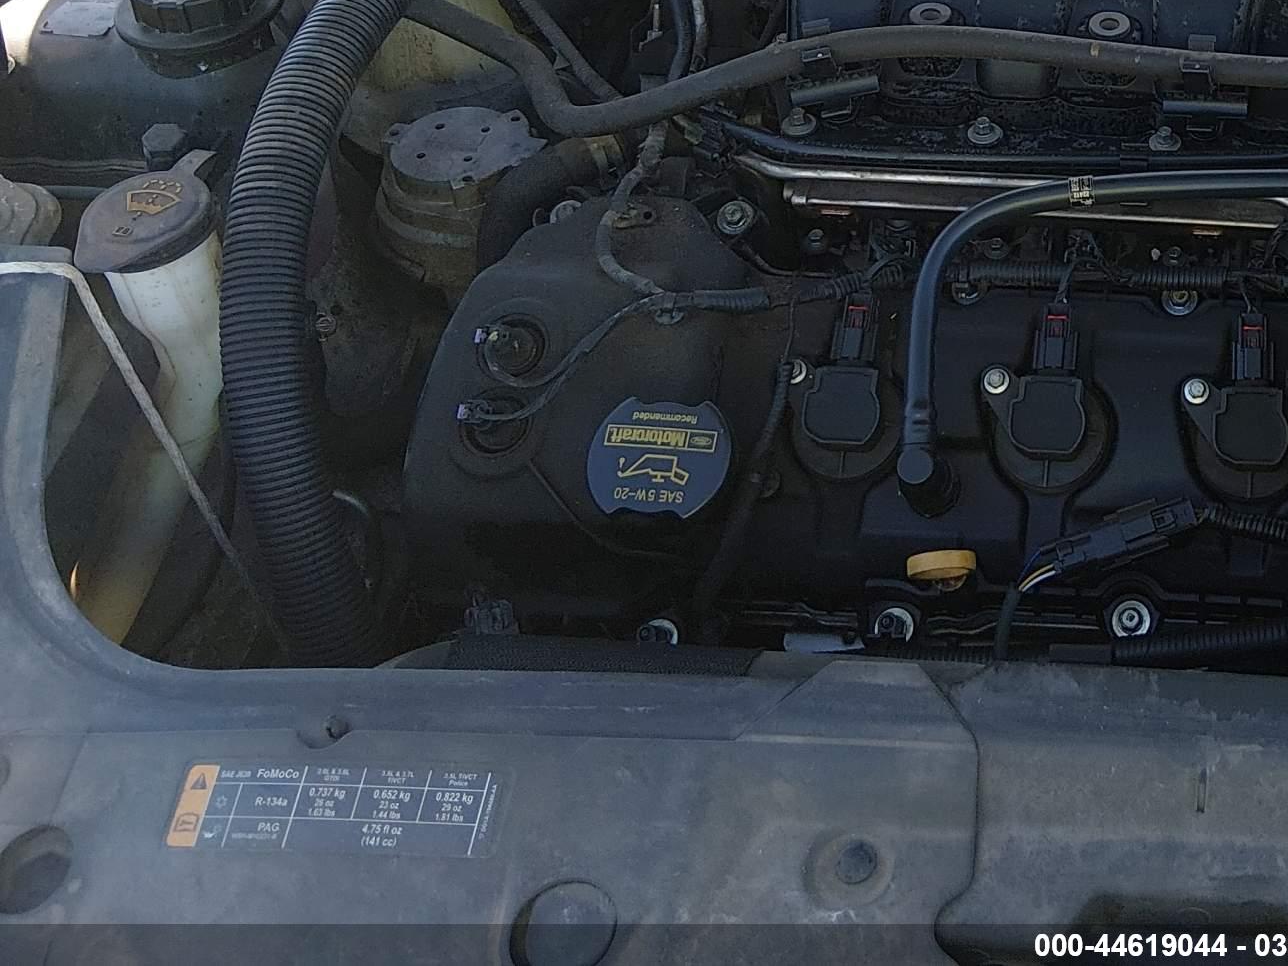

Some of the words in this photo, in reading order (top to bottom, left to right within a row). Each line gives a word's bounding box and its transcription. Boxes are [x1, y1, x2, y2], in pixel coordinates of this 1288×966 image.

[632, 411, 698, 425] Recommended
[610, 427, 687, 448] Motorcraft
[614, 487, 656, 503] 5W-20
[658, 490, 685, 504] SAE
[256, 768, 299, 779] FoMoCo
[309, 787, 334, 797] 0.737
[334, 788, 346, 800] kg
[373, 789, 398, 800] 0.652
[398, 790, 411, 802] kg
[435, 792, 460, 802] 0.822
[462, 792, 474, 805] kg
[255, 796, 288, 807] R-134a
[323, 808, 336, 817] lbs
[372, 809, 388, 819] 1.44
[389, 810, 401, 819] lbs
[257, 822, 280, 832] PAG
[361, 824, 382, 834] 4.75
[391, 827, 403, 835] oz
[360, 836, 380, 847] (141
[381, 836, 397, 847] cc)
